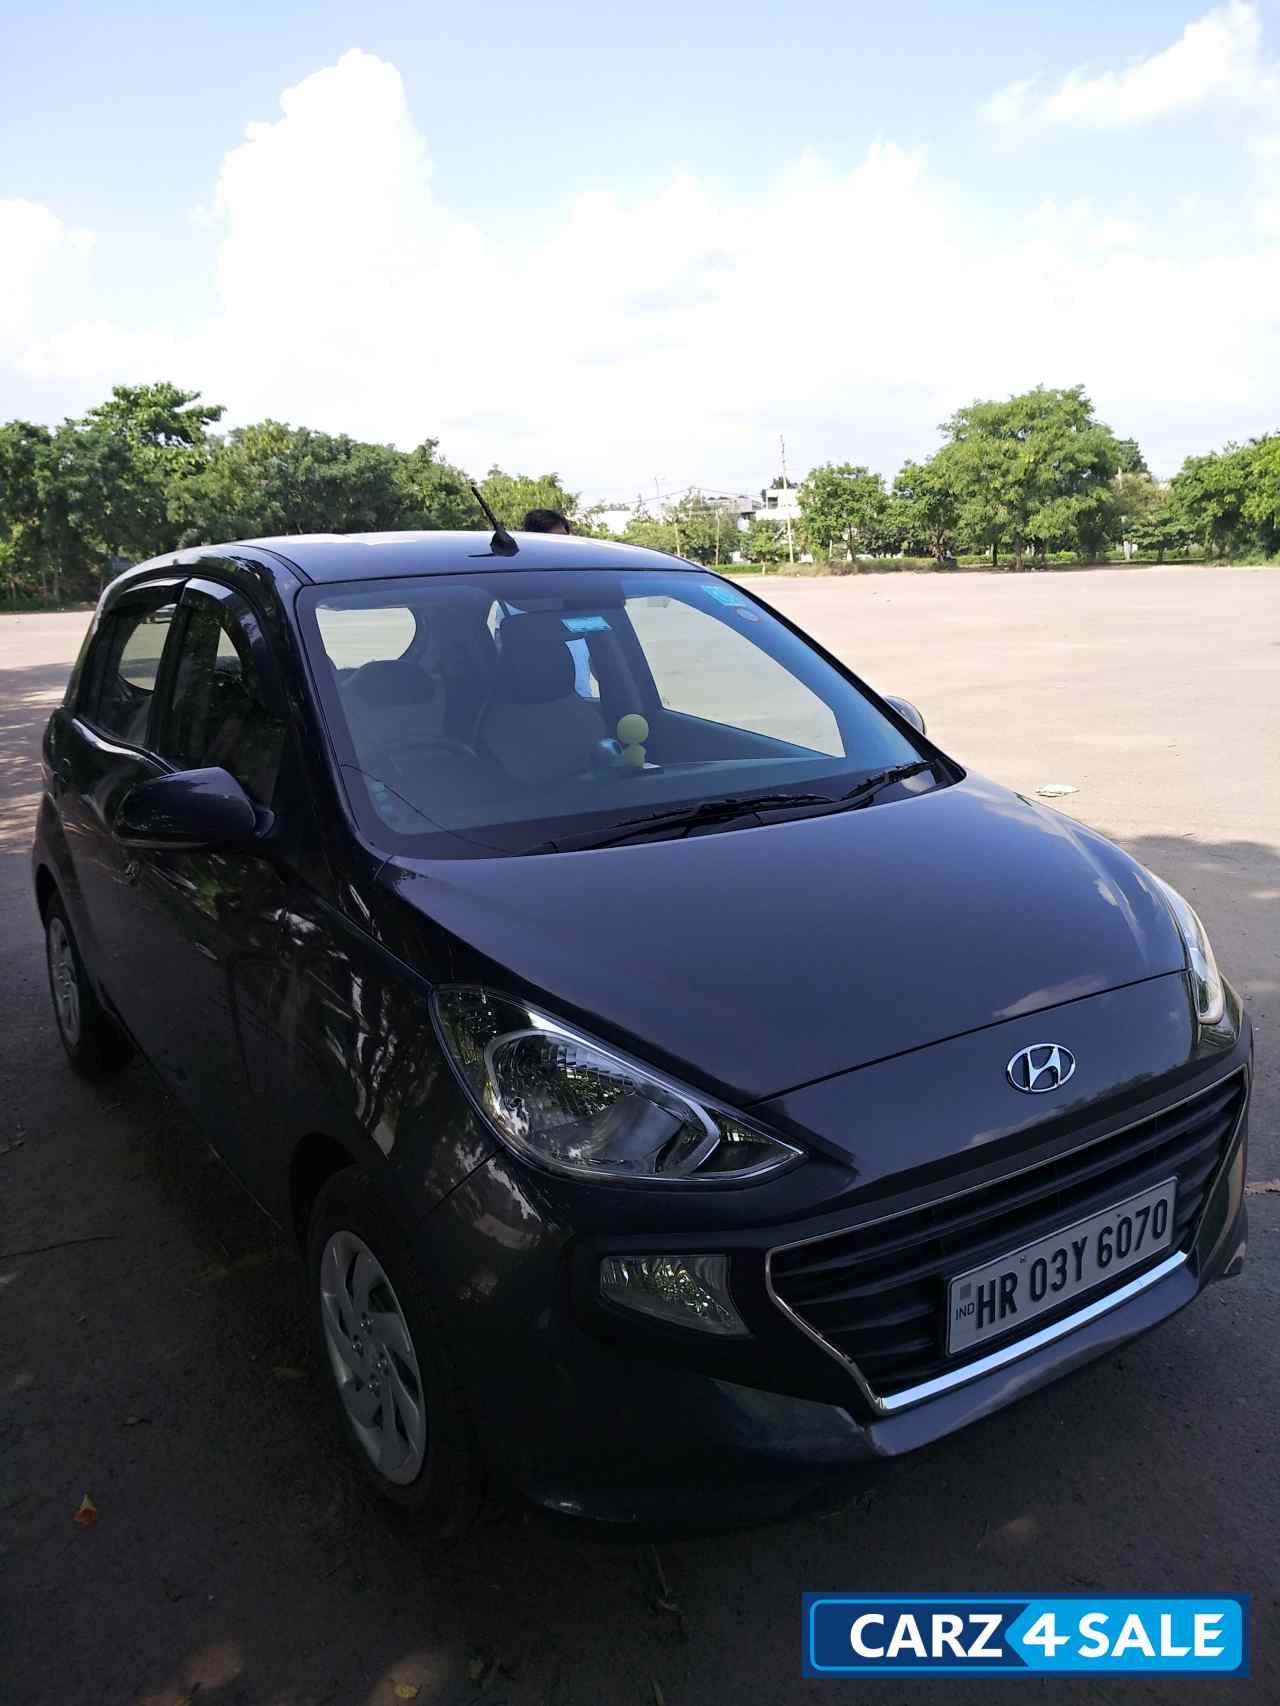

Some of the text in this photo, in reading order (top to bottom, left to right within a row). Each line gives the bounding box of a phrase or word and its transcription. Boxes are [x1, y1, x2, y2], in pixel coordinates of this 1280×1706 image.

[976, 1199, 1168, 1329] HR 03Y 6070
[955, 1302, 975, 1321] IND
